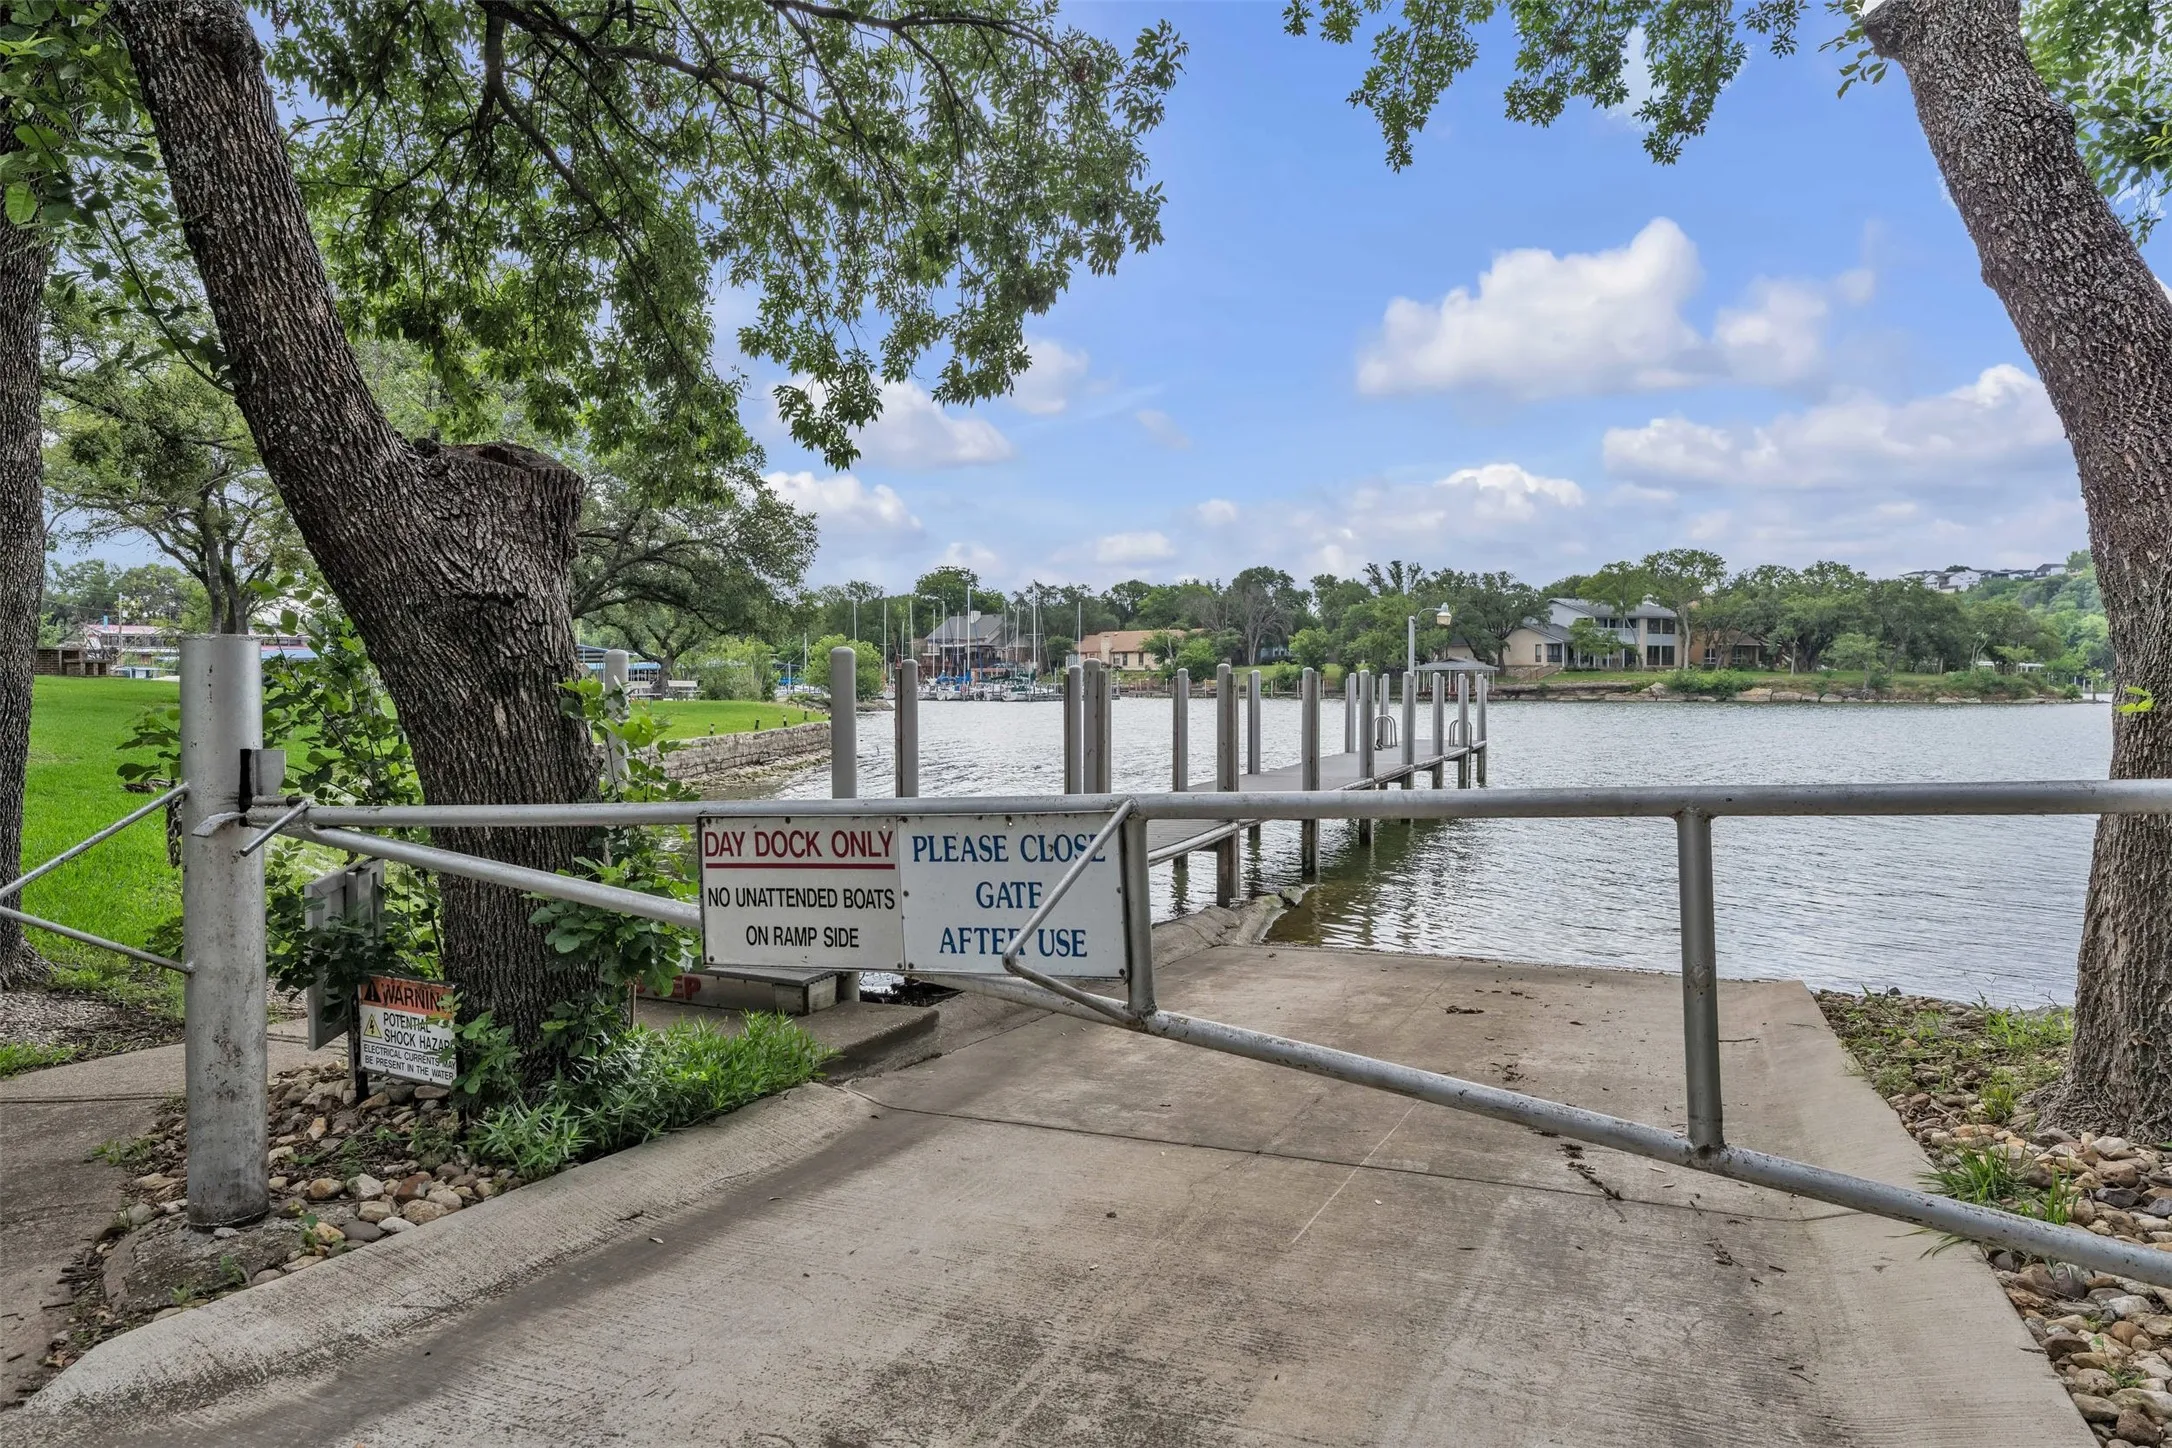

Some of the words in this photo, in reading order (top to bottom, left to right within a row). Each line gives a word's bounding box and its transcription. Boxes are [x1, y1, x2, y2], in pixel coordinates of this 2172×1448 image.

[704, 831, 746, 857] DAY
[754, 830, 822, 858] DOCK
[831, 830, 894, 858] ONLY
[911, 834, 1009, 863] PLEASE
[708, 887, 730, 908] NO
[735, 887, 838, 908] UNATTENDED
[843, 888, 895, 910] BOATS
[975, 881, 1043, 909] GATE
[746, 925, 769, 946] ON
[773, 926, 817, 947] RAMP
[823, 926, 860, 948] SIDE
[1038, 928, 1088, 958] USE
[382, 983, 453, 1014] WARNIN
[383, 1012, 431, 1033] POTENTIAL
[384, 1029, 416, 1048] SHOCK
[419, 1035, 453, 1052] HAZAR
[363, 1044, 402, 1059] ELECTRICAL
[404, 1051, 440, 1067] CURRENTS
[365, 1055, 373, 1065] BE
[376, 1057, 405, 1070] PRESENT
[407, 1064, 414, 1073] IN
[416, 1065, 429, 1076] THE
[432, 1068, 454, 1080] WATER
